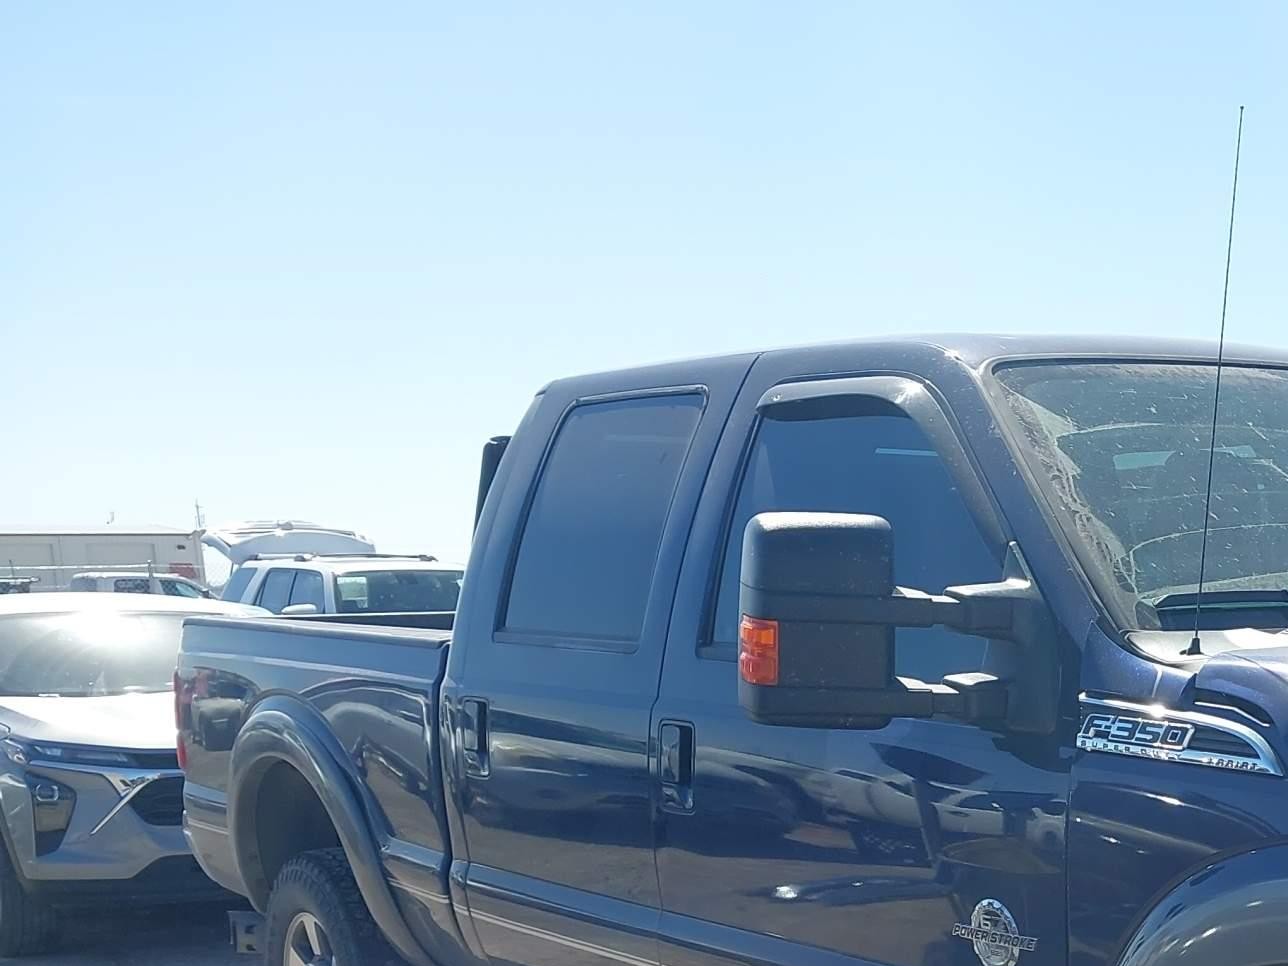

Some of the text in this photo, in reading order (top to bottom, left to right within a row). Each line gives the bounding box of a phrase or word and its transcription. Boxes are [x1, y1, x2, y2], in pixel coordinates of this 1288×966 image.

[1080, 713, 1195, 750] F-350
[1080, 740, 1183, 760] SUPER DUTY
